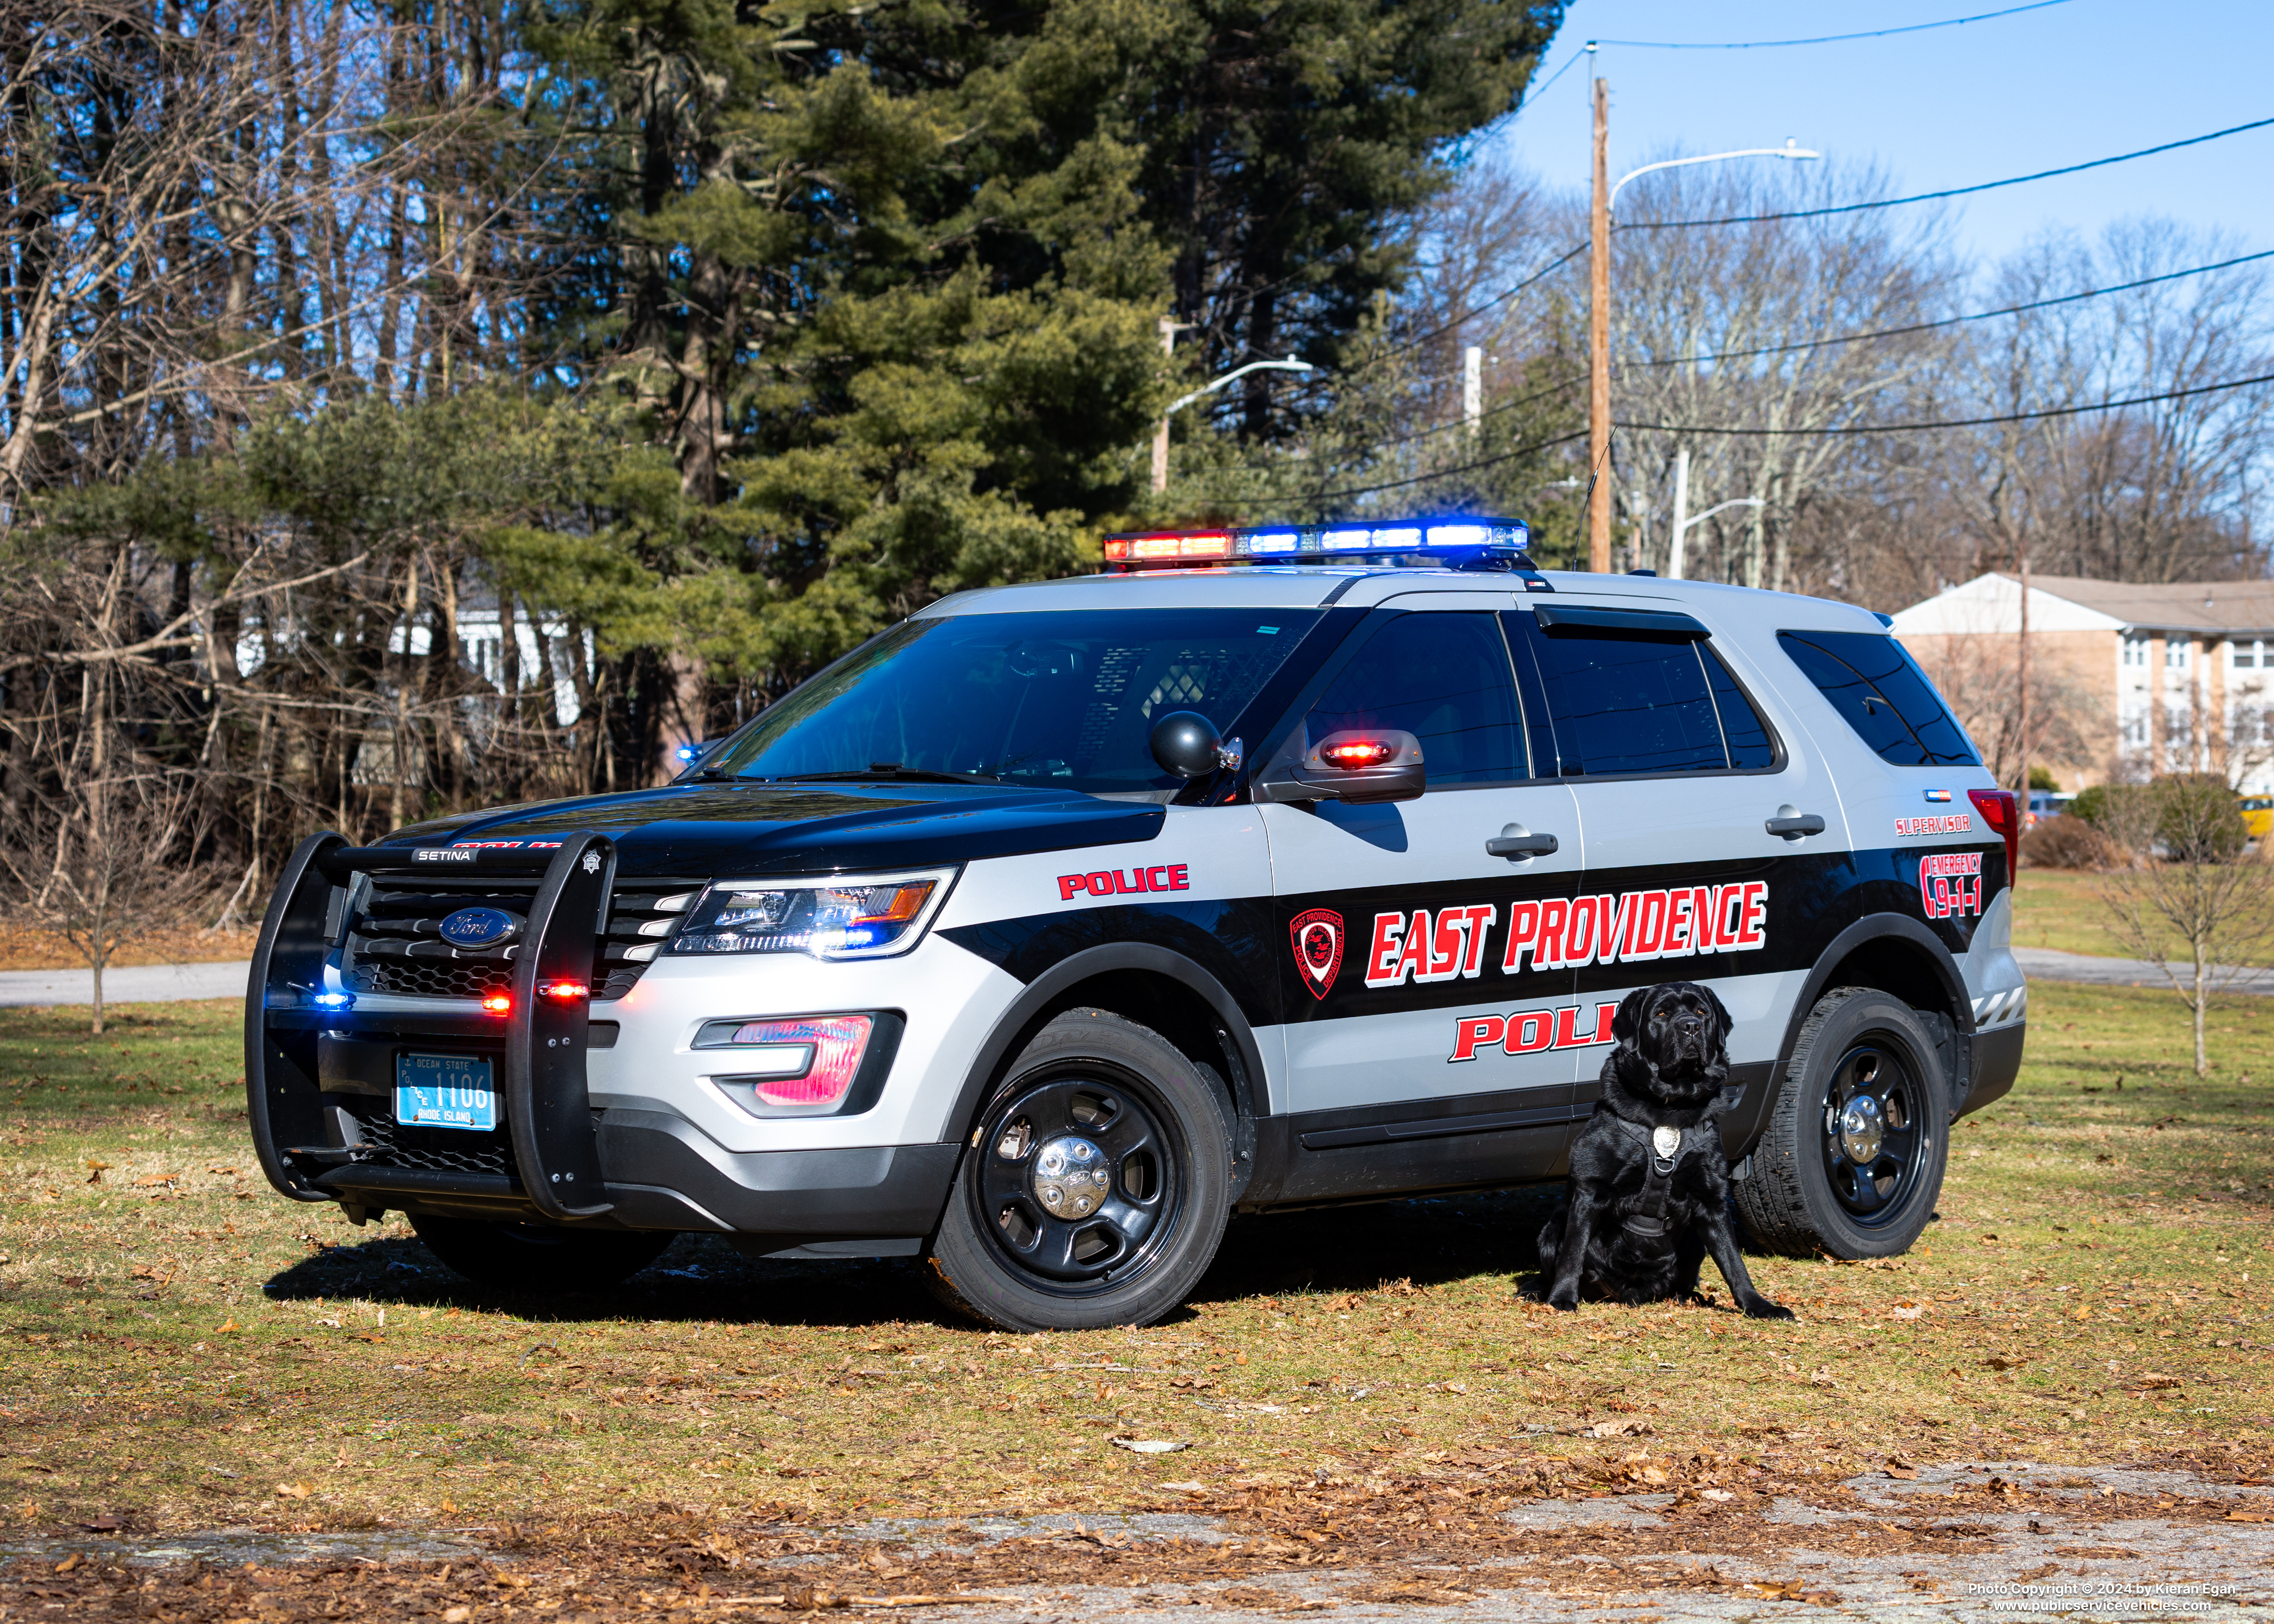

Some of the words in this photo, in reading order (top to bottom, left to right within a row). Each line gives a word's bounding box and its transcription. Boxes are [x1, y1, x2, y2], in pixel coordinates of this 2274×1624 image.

[1895, 814, 1972, 836] SUPERVISOR
[419, 852, 470, 861] SETINA
[1930, 852, 1984, 878] EMERGENCY
[1057, 863, 1189, 901] POLICE
[1934, 875, 1982, 919] 9-1-1
[450, 913, 493, 935] Ford
[1292, 916, 1306, 933] EAST
[1306, 912, 1342, 928] PROVIDENCE
[1306, 927, 1317, 945] RHODE
[1318, 926, 1331, 942] ISLAND
[1364, 904, 1496, 988] EAST
[1501, 881, 1769, 976] PROVIDENCE
[1295, 946, 1312, 981] POLICE
[1323, 930, 1342, 988] DEPARTMENT
[1321, 947, 1332, 966] PUBLICO
[1447, 1000, 1620, 1064] POLI
[417, 1059, 440, 1069] OCEAN
[445, 1060, 469, 1070] STATE
[436, 1072, 487, 1109] 1106
[418, 1109, 441, 1121] RHODE
[444, 1110, 471, 1123] ISLAND
